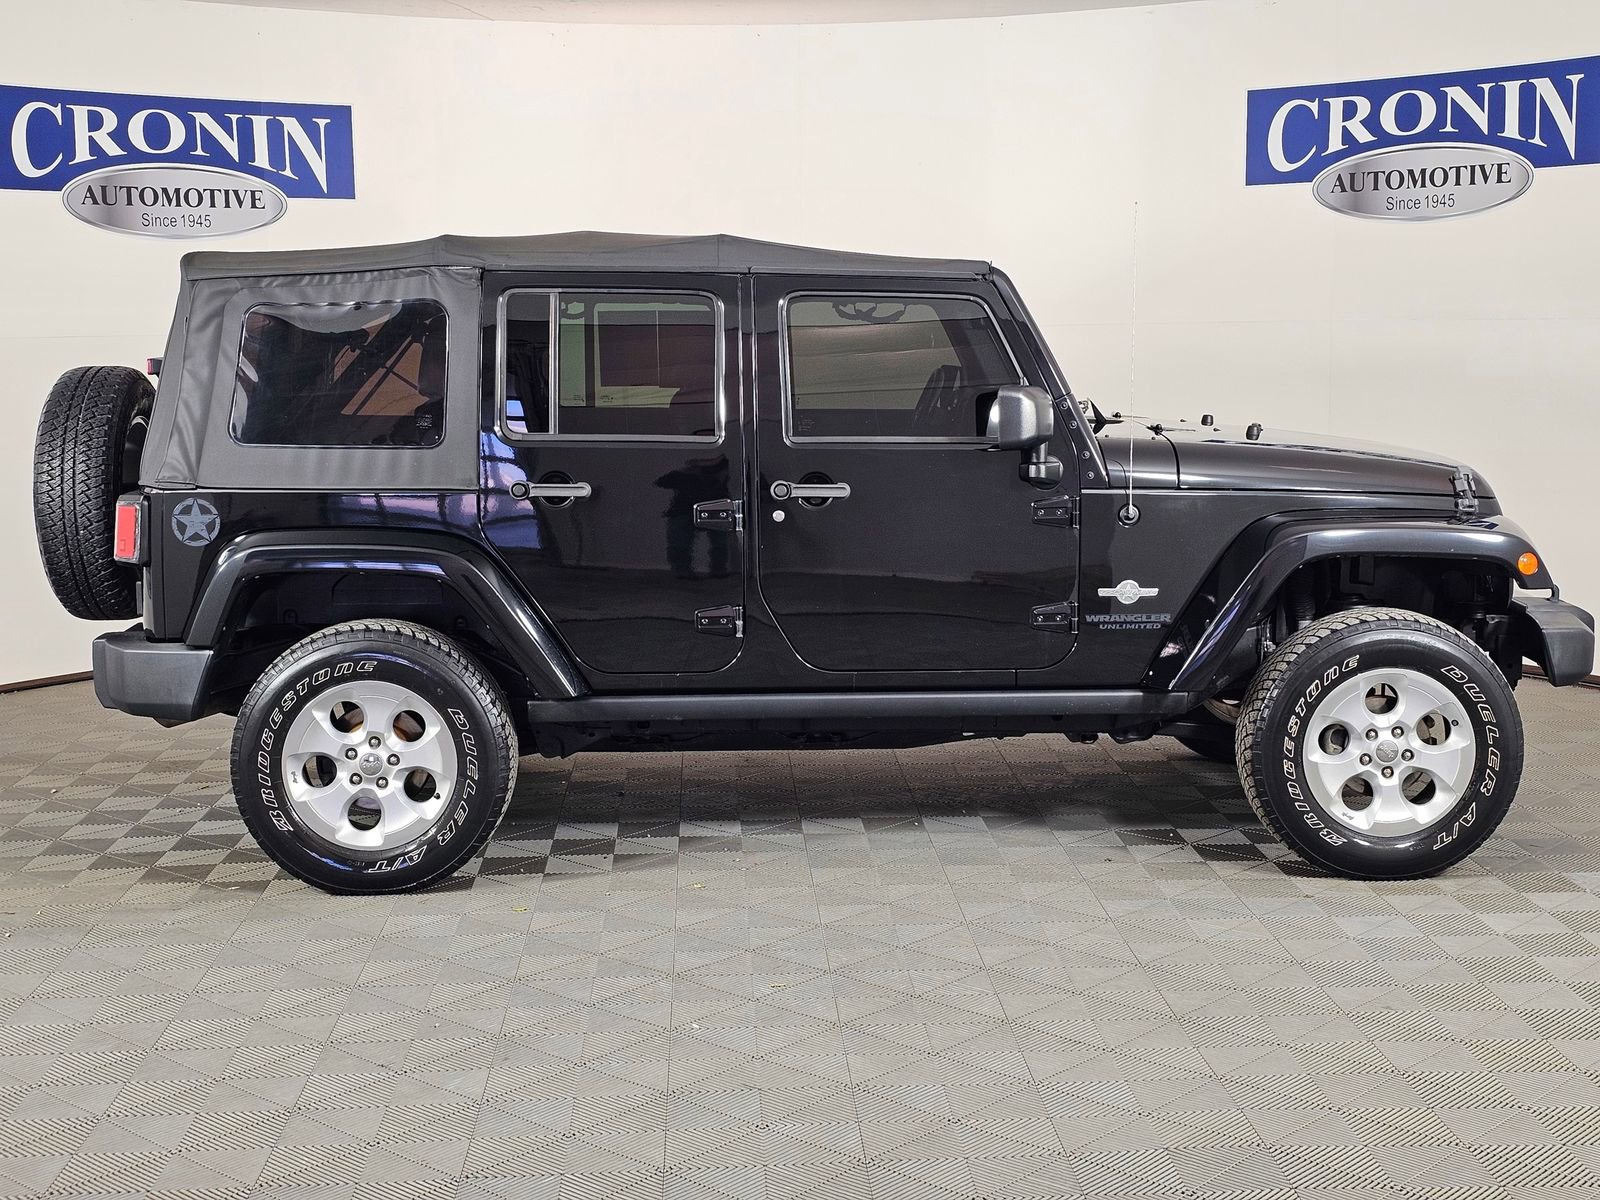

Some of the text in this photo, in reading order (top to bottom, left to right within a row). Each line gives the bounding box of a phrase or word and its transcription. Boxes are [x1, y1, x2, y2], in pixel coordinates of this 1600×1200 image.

[11, 101, 331, 194] CRONIN
[1267, 73, 1584, 172] CRONIN
[81, 185, 266, 209] AUTOMOTIVE
[1330, 163, 1512, 193] AUTOMOTIVE
[1385, 193, 1455, 211] Since 1945
[141, 213, 212, 228] Since 1945
[1085, 613, 1171, 622] WRANGLER
[1100, 622, 1161, 630] UNLIMITED
[258, 660, 378, 832] BRIDGESTONE
[1283, 654, 1359, 847] BRIDGESTONE
[1433, 664, 1500, 850] DUELER A/T
[367, 707, 479, 873] DUELER A/T
